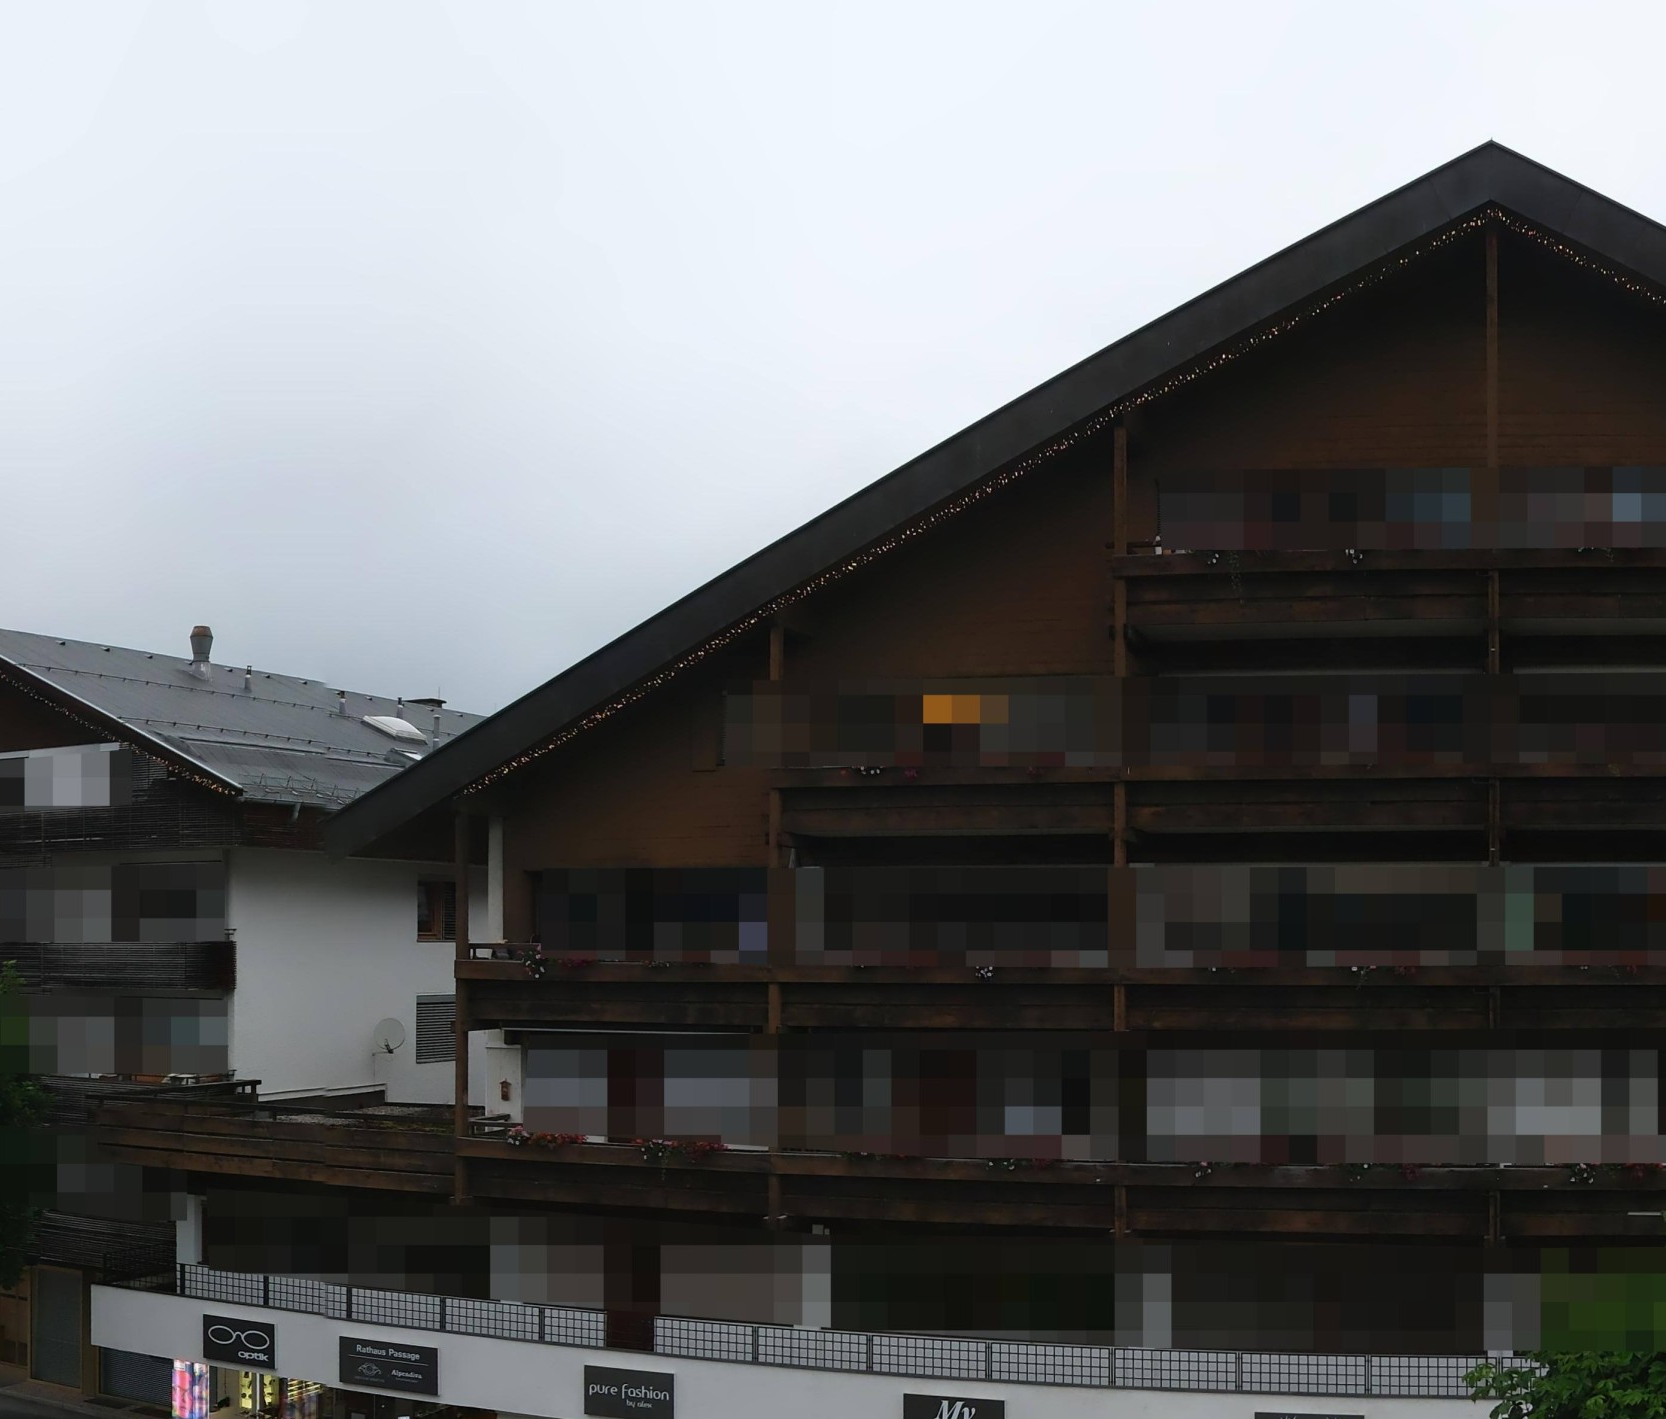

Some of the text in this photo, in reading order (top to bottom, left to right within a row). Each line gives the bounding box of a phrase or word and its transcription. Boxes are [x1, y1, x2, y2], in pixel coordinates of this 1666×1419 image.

[237, 1350, 270, 1362] optik
[356, 1344, 421, 1361] Rathaus Passage
[589, 1383, 670, 1401] pure fashion
[626, 1400, 653, 1409] by alex
